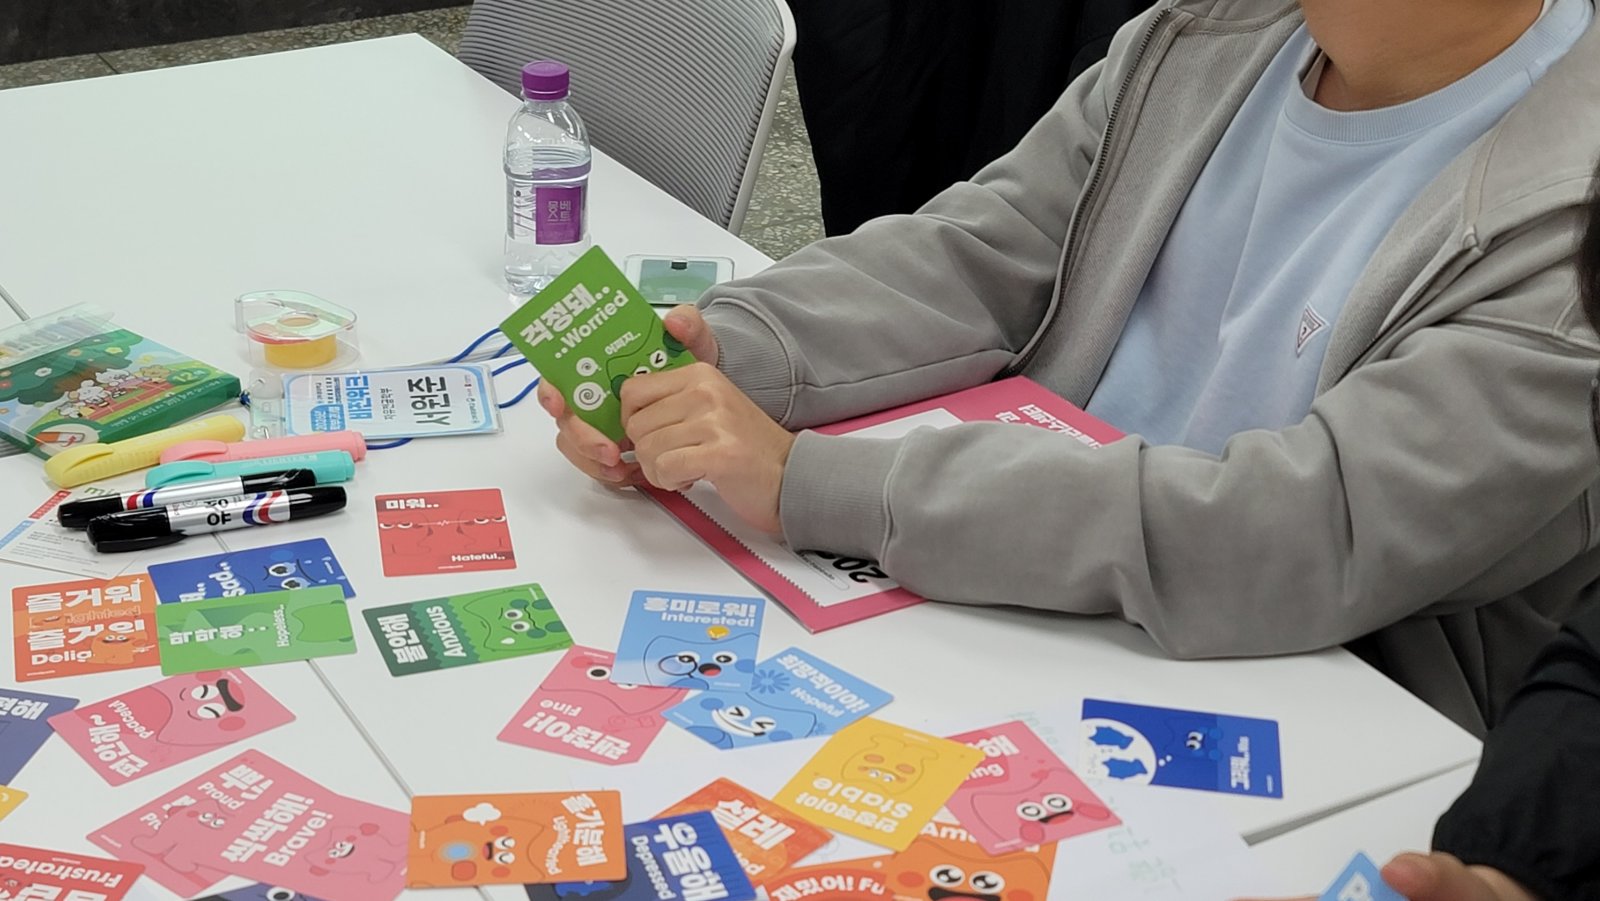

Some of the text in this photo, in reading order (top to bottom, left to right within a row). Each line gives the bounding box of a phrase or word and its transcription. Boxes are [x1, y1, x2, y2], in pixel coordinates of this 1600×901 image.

[519, 283, 610, 347] 걱정돼..
[407, 376, 452, 426] 서원준
[386, 498, 439, 510] 미워..
[451, 553, 505, 563] Hateful..
[26, 581, 143, 613] 즐거워
[643, 597, 757, 618] 흥미로워!
[661, 612, 755, 628] Interested!
[377, 612, 428, 664] 불안해
[426, 605, 467, 658] Anxious
[540, 699, 582, 718] Fine
[790, 687, 845, 719] Hopeful
[523, 711, 631, 760] 괜찮아!
[197, 781, 245, 811] Proud
[794, 792, 899, 834] 안정적이야
[812, 776, 913, 819] Stable
[221, 792, 315, 864] 씩씩해!
[263, 810, 335, 867] Brave!
[561, 793, 608, 868] 홀가분해
[631, 835, 677, 901] Depressed
[653, 822, 729, 901] 우울해
